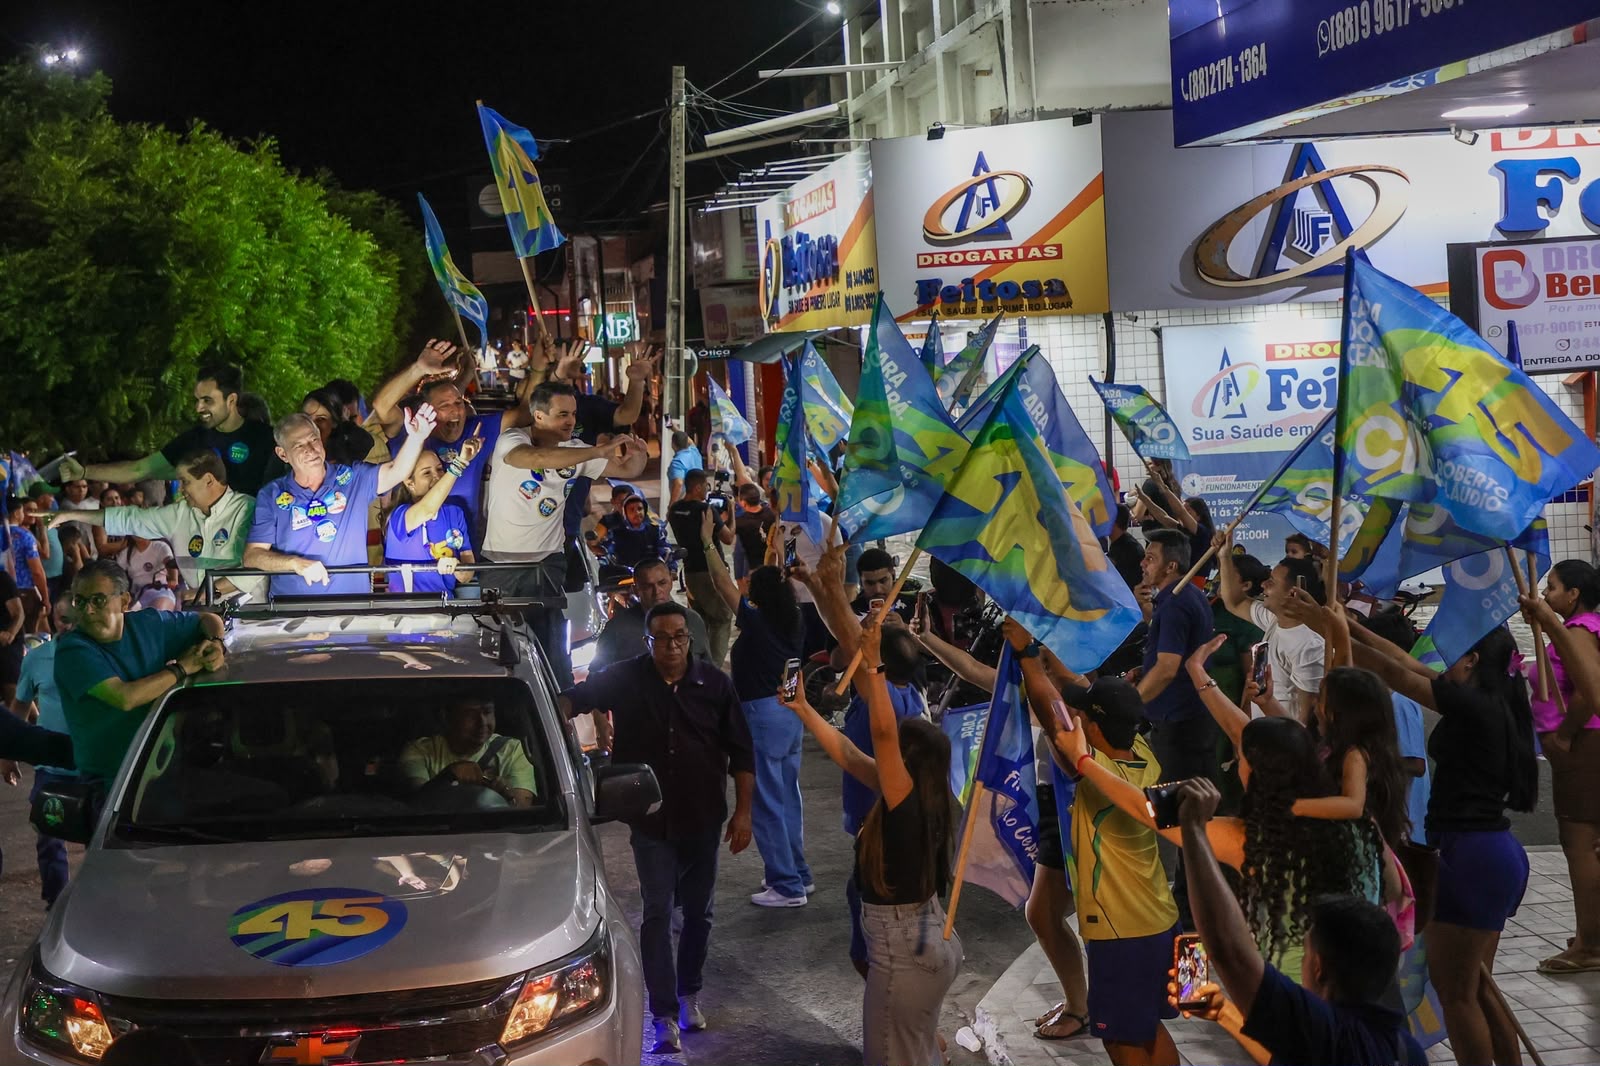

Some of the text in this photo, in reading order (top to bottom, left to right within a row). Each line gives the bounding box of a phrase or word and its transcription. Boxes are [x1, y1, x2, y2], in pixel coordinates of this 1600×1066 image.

[918, 246, 1058, 266] DROGARIAS
[915, 277, 1068, 304] Feitosa
[921, 307, 941, 317] SUA
[981, 304, 994, 314] EM
[997, 302, 1041, 313] PRIMEIRO
[1043, 300, 1073, 312] LUGAR
[1549, 304, 1571, 312] Por
[1524, 356, 1572, 366] ENTREGA
[1017, 383, 1050, 432] CARA
[802, 404, 845, 446] 45
[1192, 423, 1313, 441] Sua Saúde em
[1437, 458, 1509, 501] ROBERTO
[1236, 530, 1269, 541] 21:00H
[238, 896, 390, 940] 45
